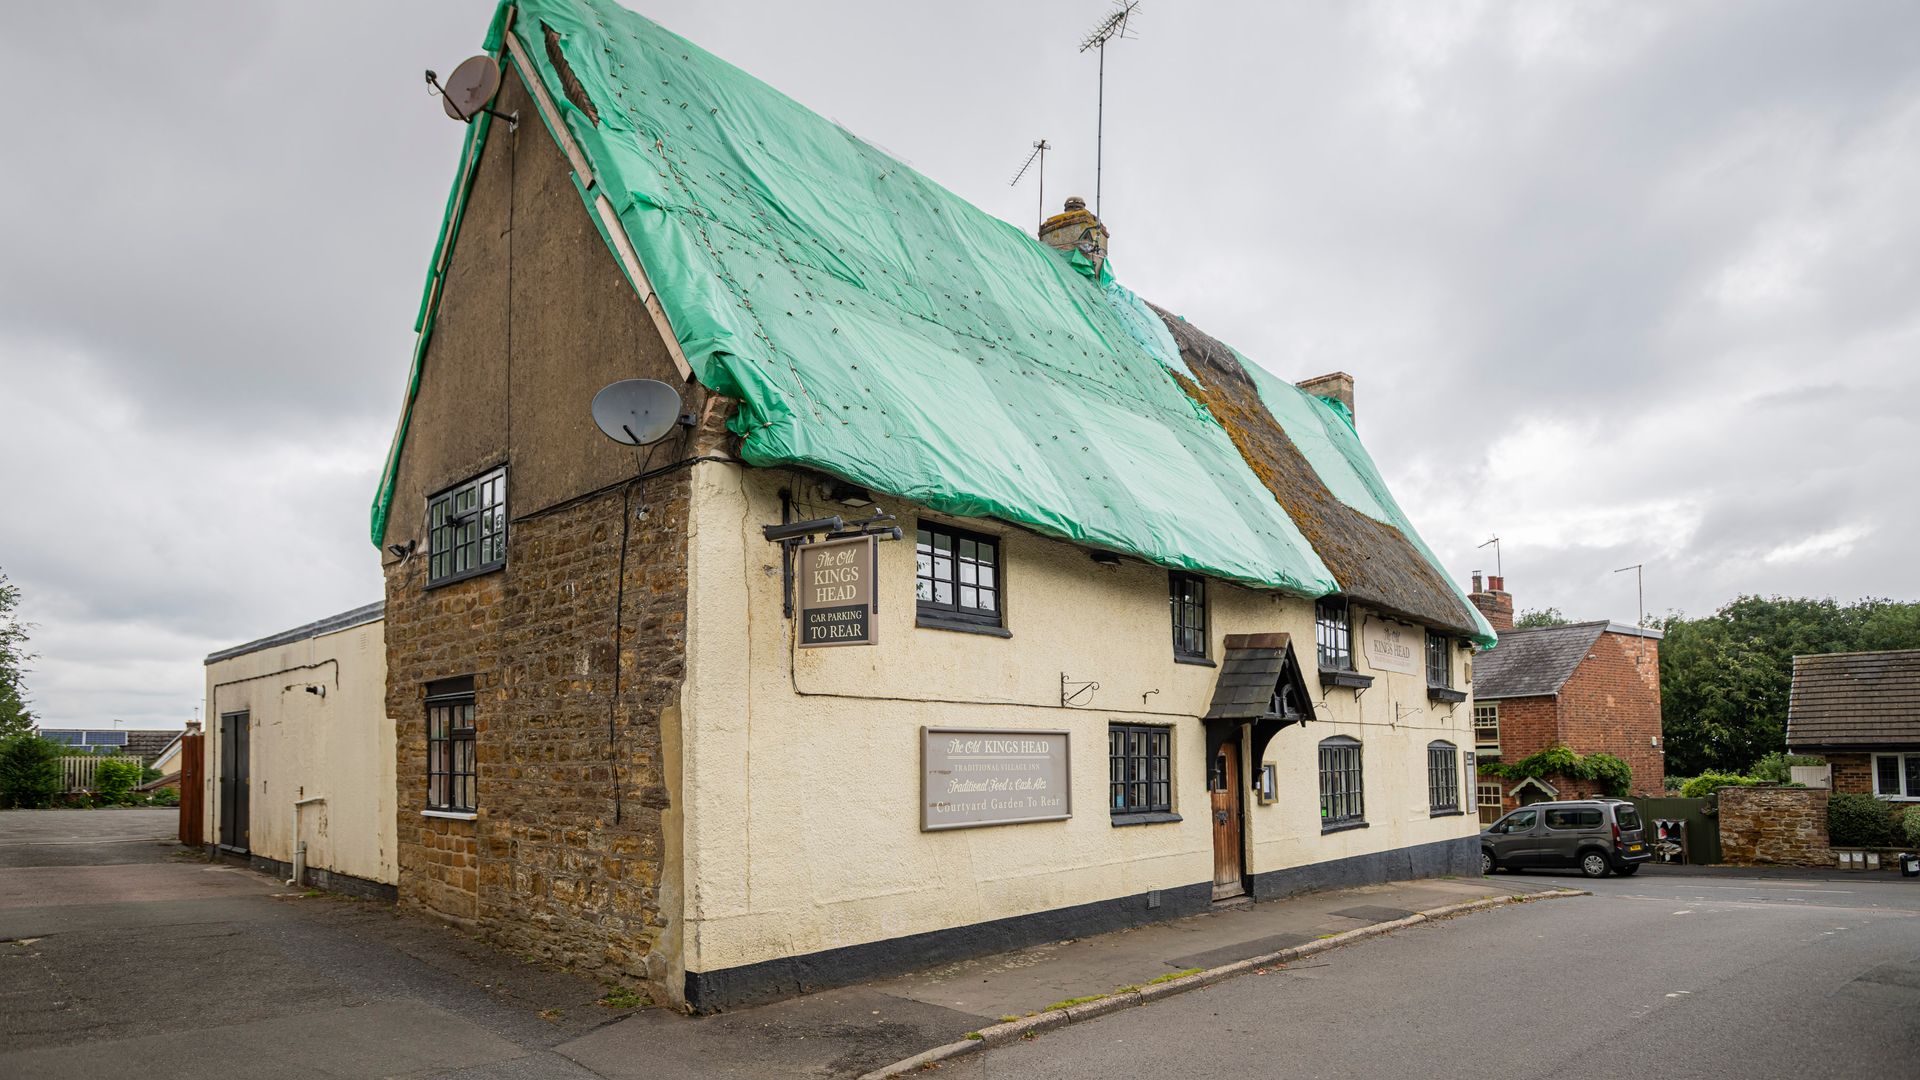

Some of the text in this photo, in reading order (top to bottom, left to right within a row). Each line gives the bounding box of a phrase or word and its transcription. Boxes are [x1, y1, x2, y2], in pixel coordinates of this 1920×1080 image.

[816, 548, 857, 568] The Old
[814, 566, 859, 585] KINGS
[815, 584, 857, 602] HEAD
[810, 610, 862, 623] CAR PARKING
[810, 623, 862, 639] TO REAR
[1373, 639, 1410, 658] KINGS HEAD
[947, 738, 1049, 754] The Old KINGS HEAD
[954, 763, 1000, 772] TRADITIONAL
[947, 777, 989, 793] Traditional
[989, 777, 1008, 792] Food
[936, 795, 1060, 816] Courtyard Garden To Rear
